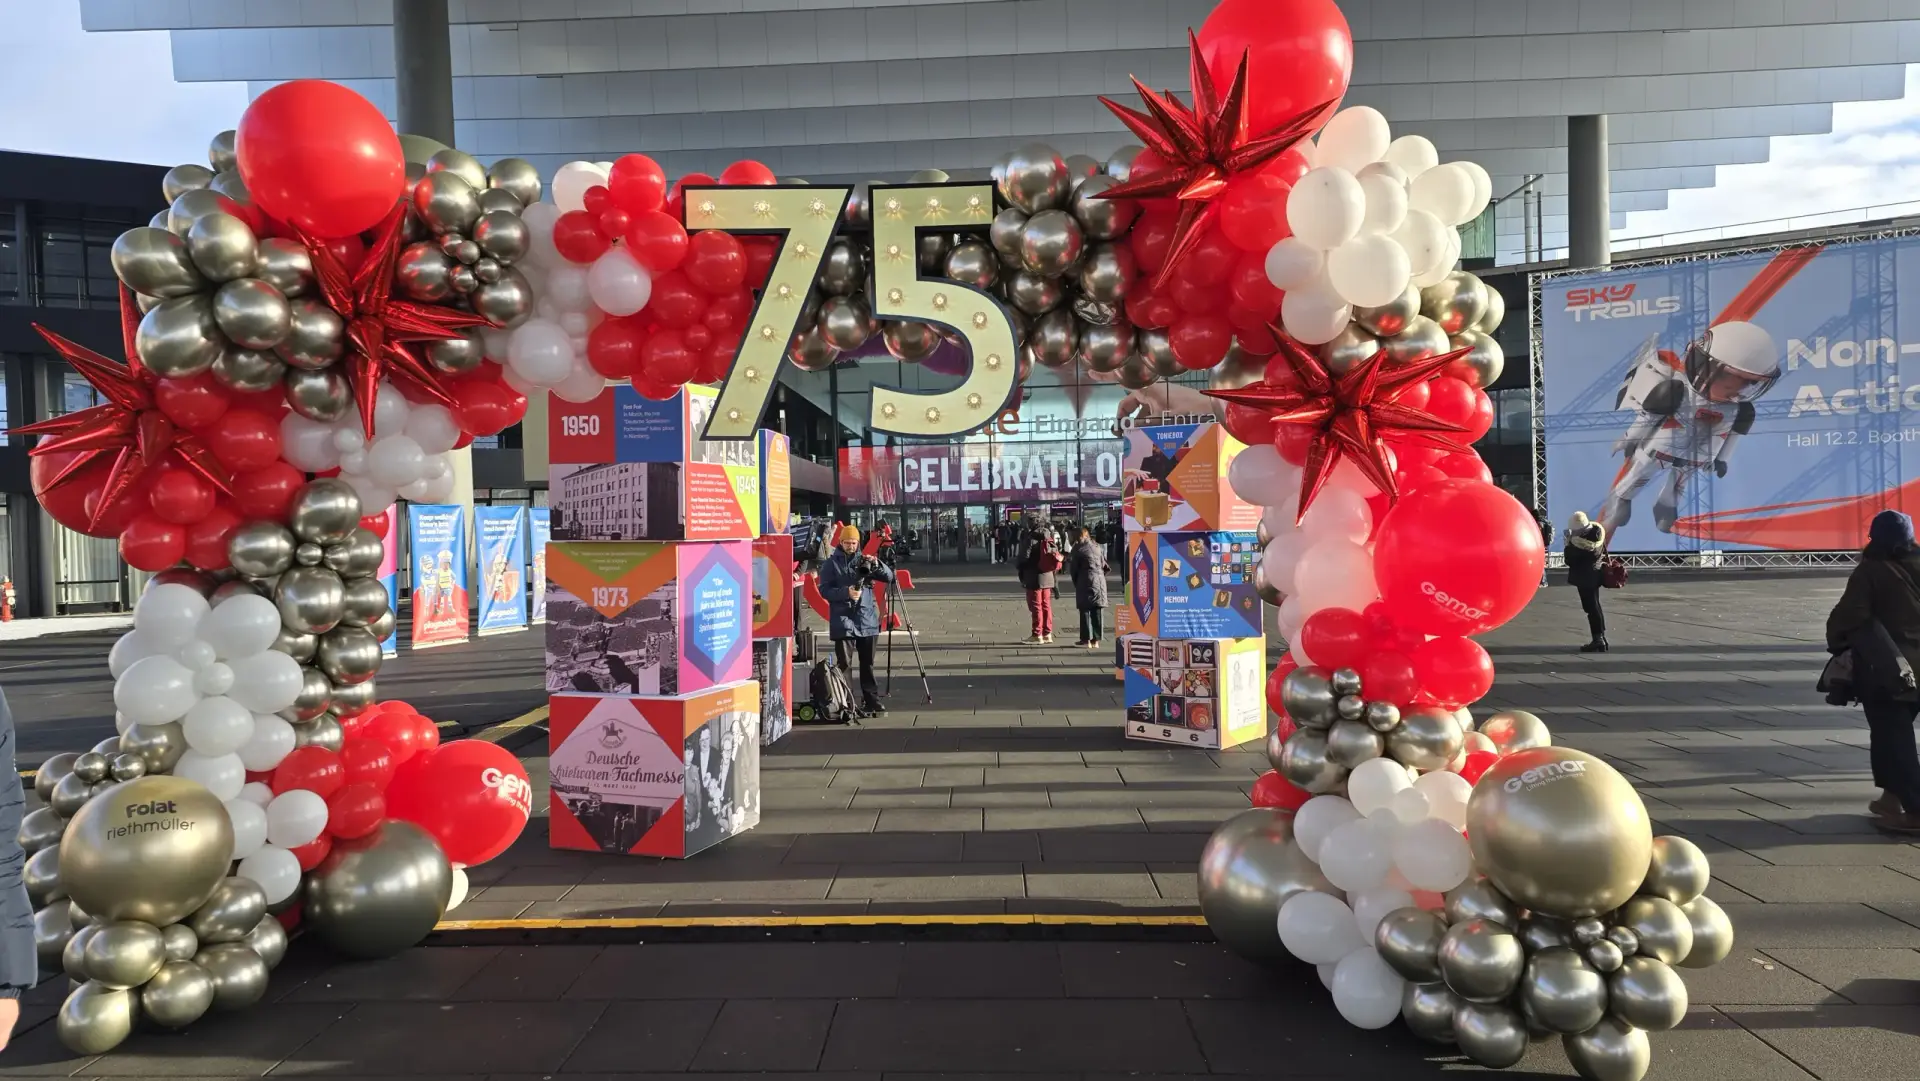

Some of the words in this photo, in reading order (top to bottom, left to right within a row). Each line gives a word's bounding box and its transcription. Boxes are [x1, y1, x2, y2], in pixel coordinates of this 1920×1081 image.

[1566, 284, 1636, 307] SKY
[681, 180, 1020, 440] 75
[1563, 296, 1681, 322] TRAILS
[561, 415, 600, 436] 1950
[1035, 413, 1135, 438] Eingang
[1161, 410, 1218, 426] Entra
[1156, 431, 1184, 440] TONIEBOX
[1787, 433, 1819, 447] Hall
[1868, 428, 1920, 444] Booth
[897, 452, 1086, 494] CELEBRATE
[736, 475, 757, 495] 1949
[591, 586, 629, 607] 1973
[1164, 595, 1189, 604] MEMORY
[1420, 581, 1491, 620] Gemar
[1136, 725, 1146, 733] 4
[1162, 729, 1171, 737] 5
[1190, 733, 1199, 742] 6
[586, 750, 640, 766] Deutsche
[481, 767, 532, 803] Gem
[1503, 760, 1588, 793] Gemar
[126, 800, 177, 818] Folat
[107, 818, 196, 840] riethmüller
